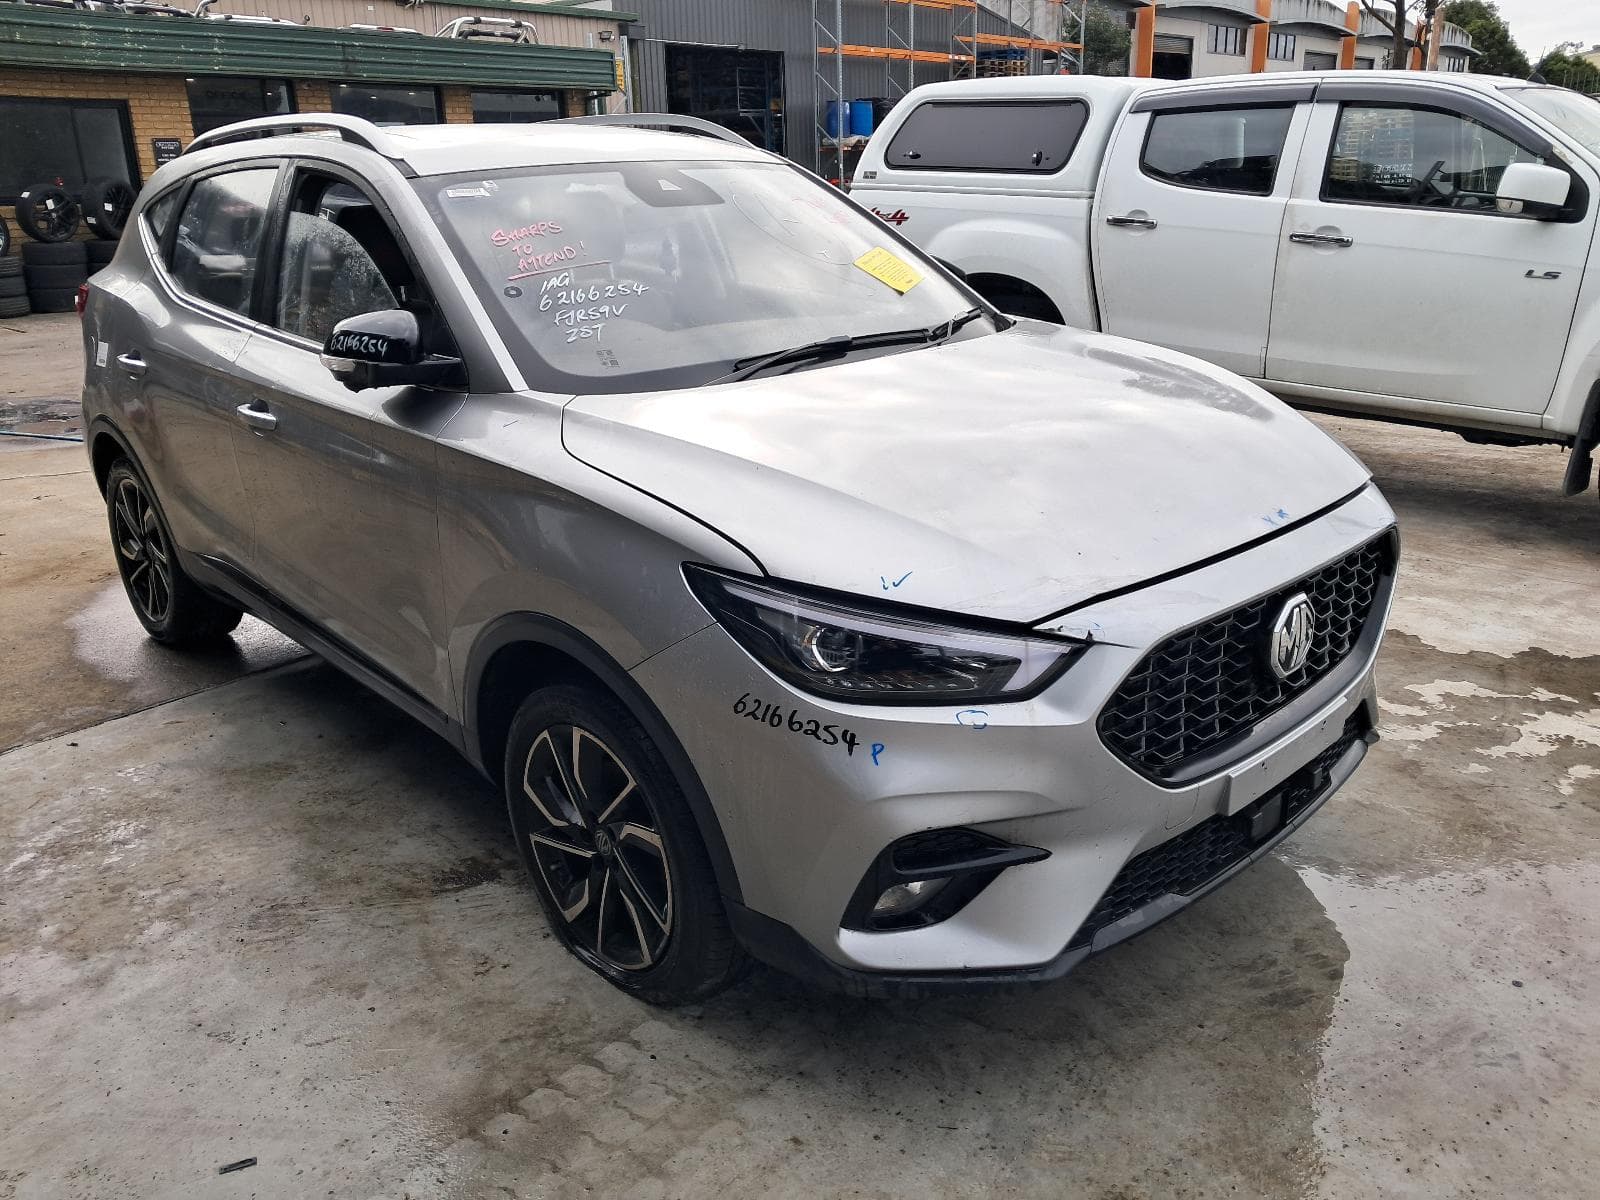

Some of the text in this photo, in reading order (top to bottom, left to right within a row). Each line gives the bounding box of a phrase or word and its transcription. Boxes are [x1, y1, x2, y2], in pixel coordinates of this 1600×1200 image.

[491, 221, 562, 247] SHARPS
[512, 244, 532, 256] TO
[540, 283, 649, 312] 62166254
[1276, 599, 1314, 673] MG
[733, 693, 860, 756] 62166254
[871, 743, 884, 766] P
